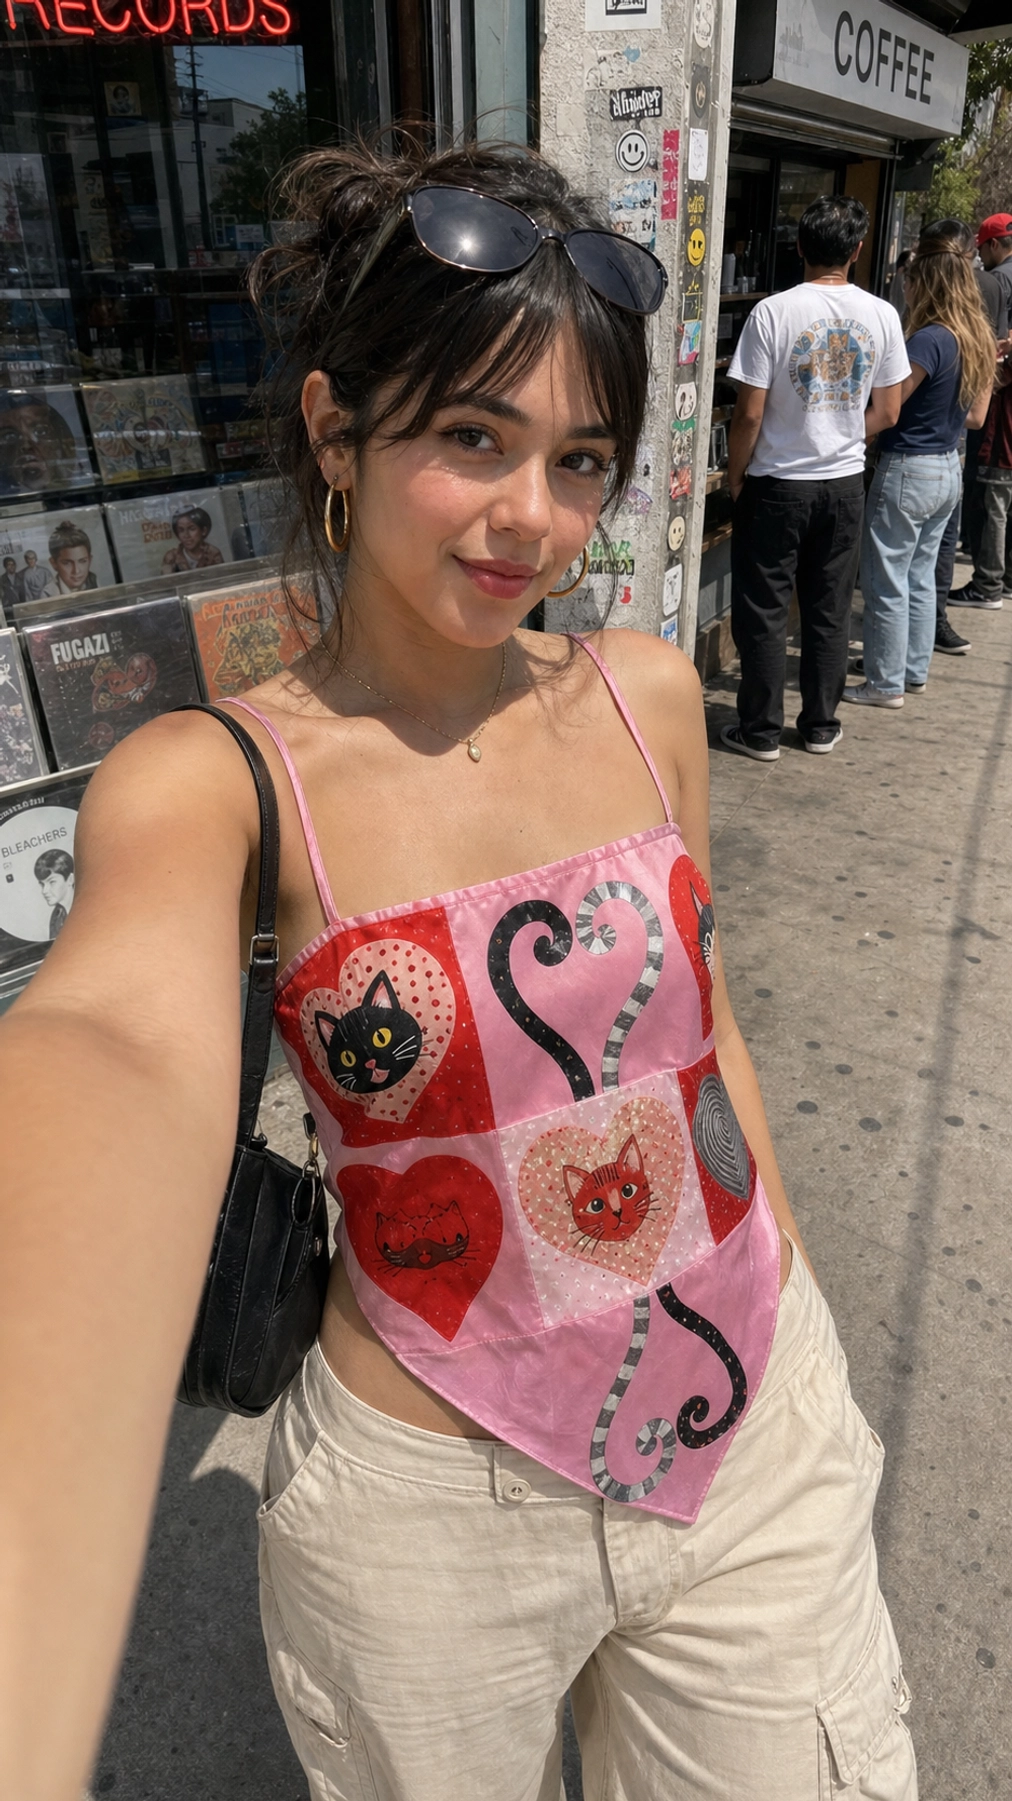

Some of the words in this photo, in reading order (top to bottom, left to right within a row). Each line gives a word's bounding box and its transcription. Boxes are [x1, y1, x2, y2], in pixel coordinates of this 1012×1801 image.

[834, 11, 935, 105] COFFEE
[50, 633, 110, 665] FUGAZI
[1, 827, 68, 858] BLEACHERS
